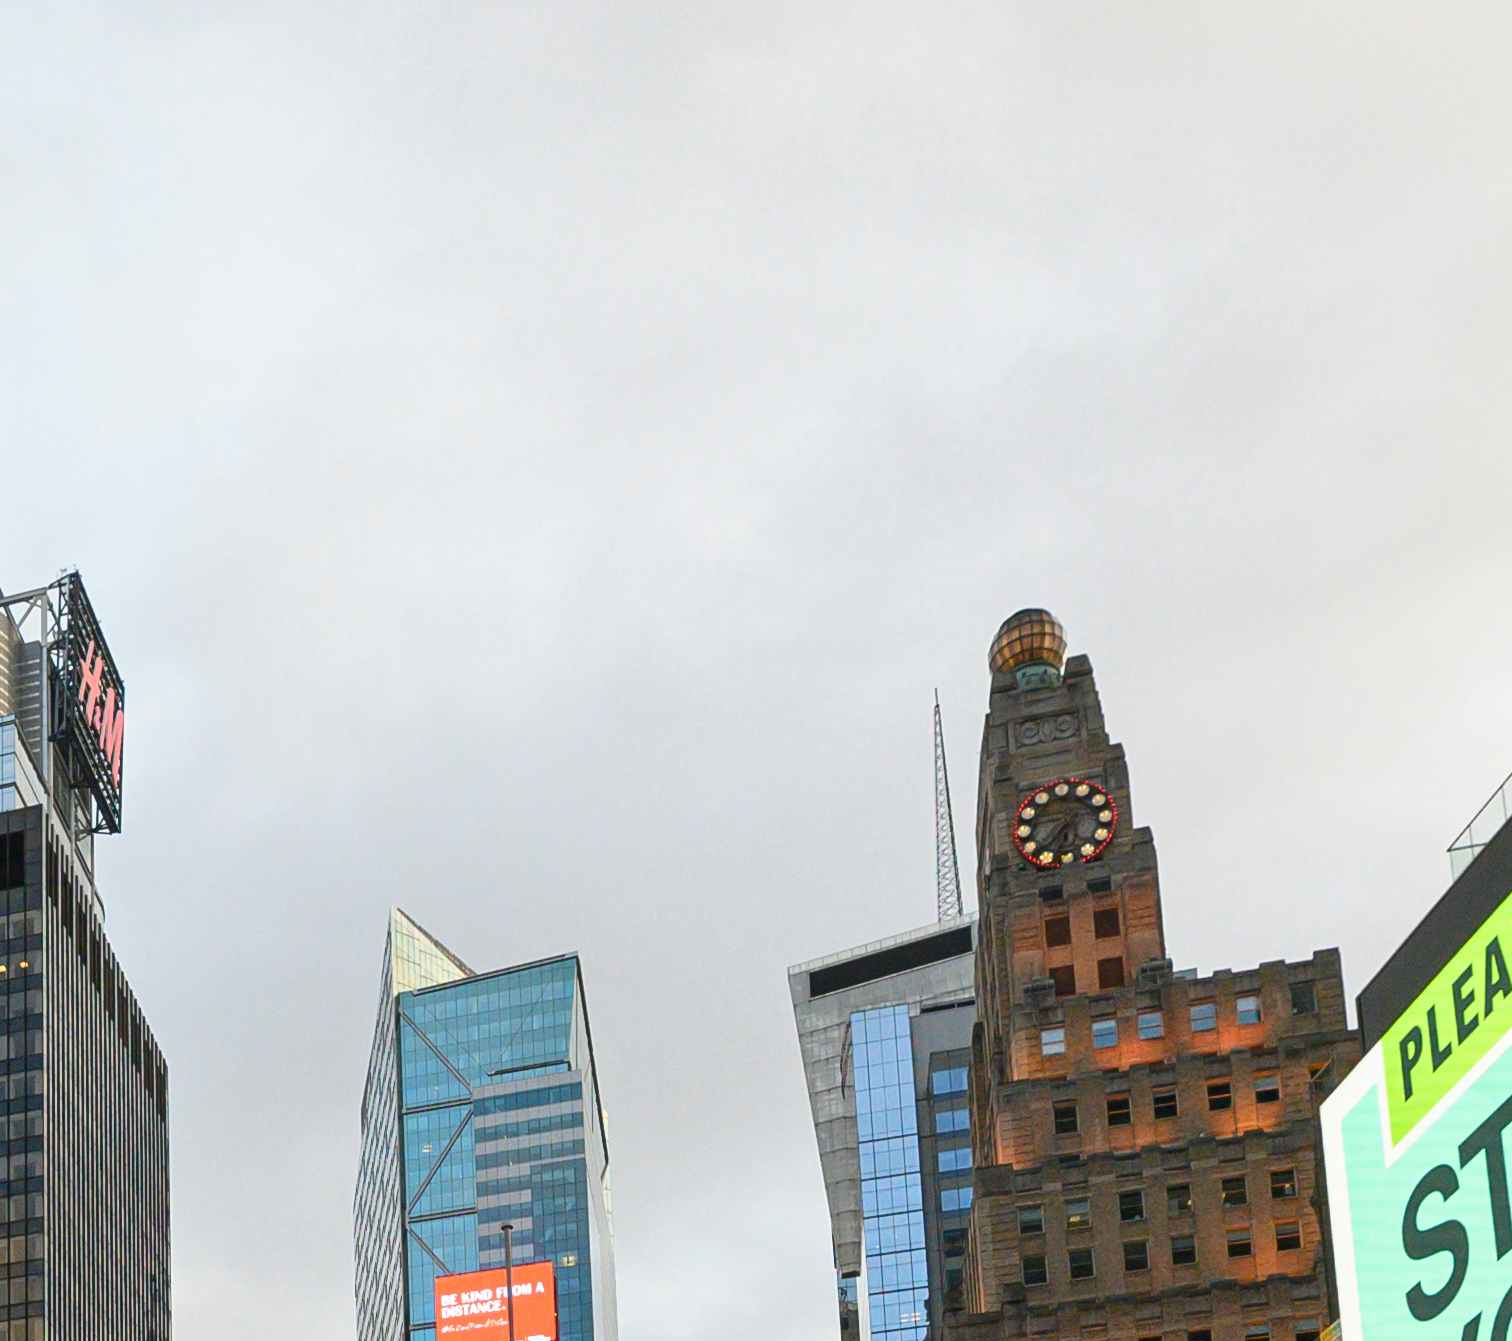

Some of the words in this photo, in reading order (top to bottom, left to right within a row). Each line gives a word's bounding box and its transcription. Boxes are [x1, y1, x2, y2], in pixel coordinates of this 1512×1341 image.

[78, 640, 124, 788] H&M
[441, 1293, 459, 1307] BE
[461, 1288, 493, 1303] KIND
[536, 1281, 545, 1293] A
